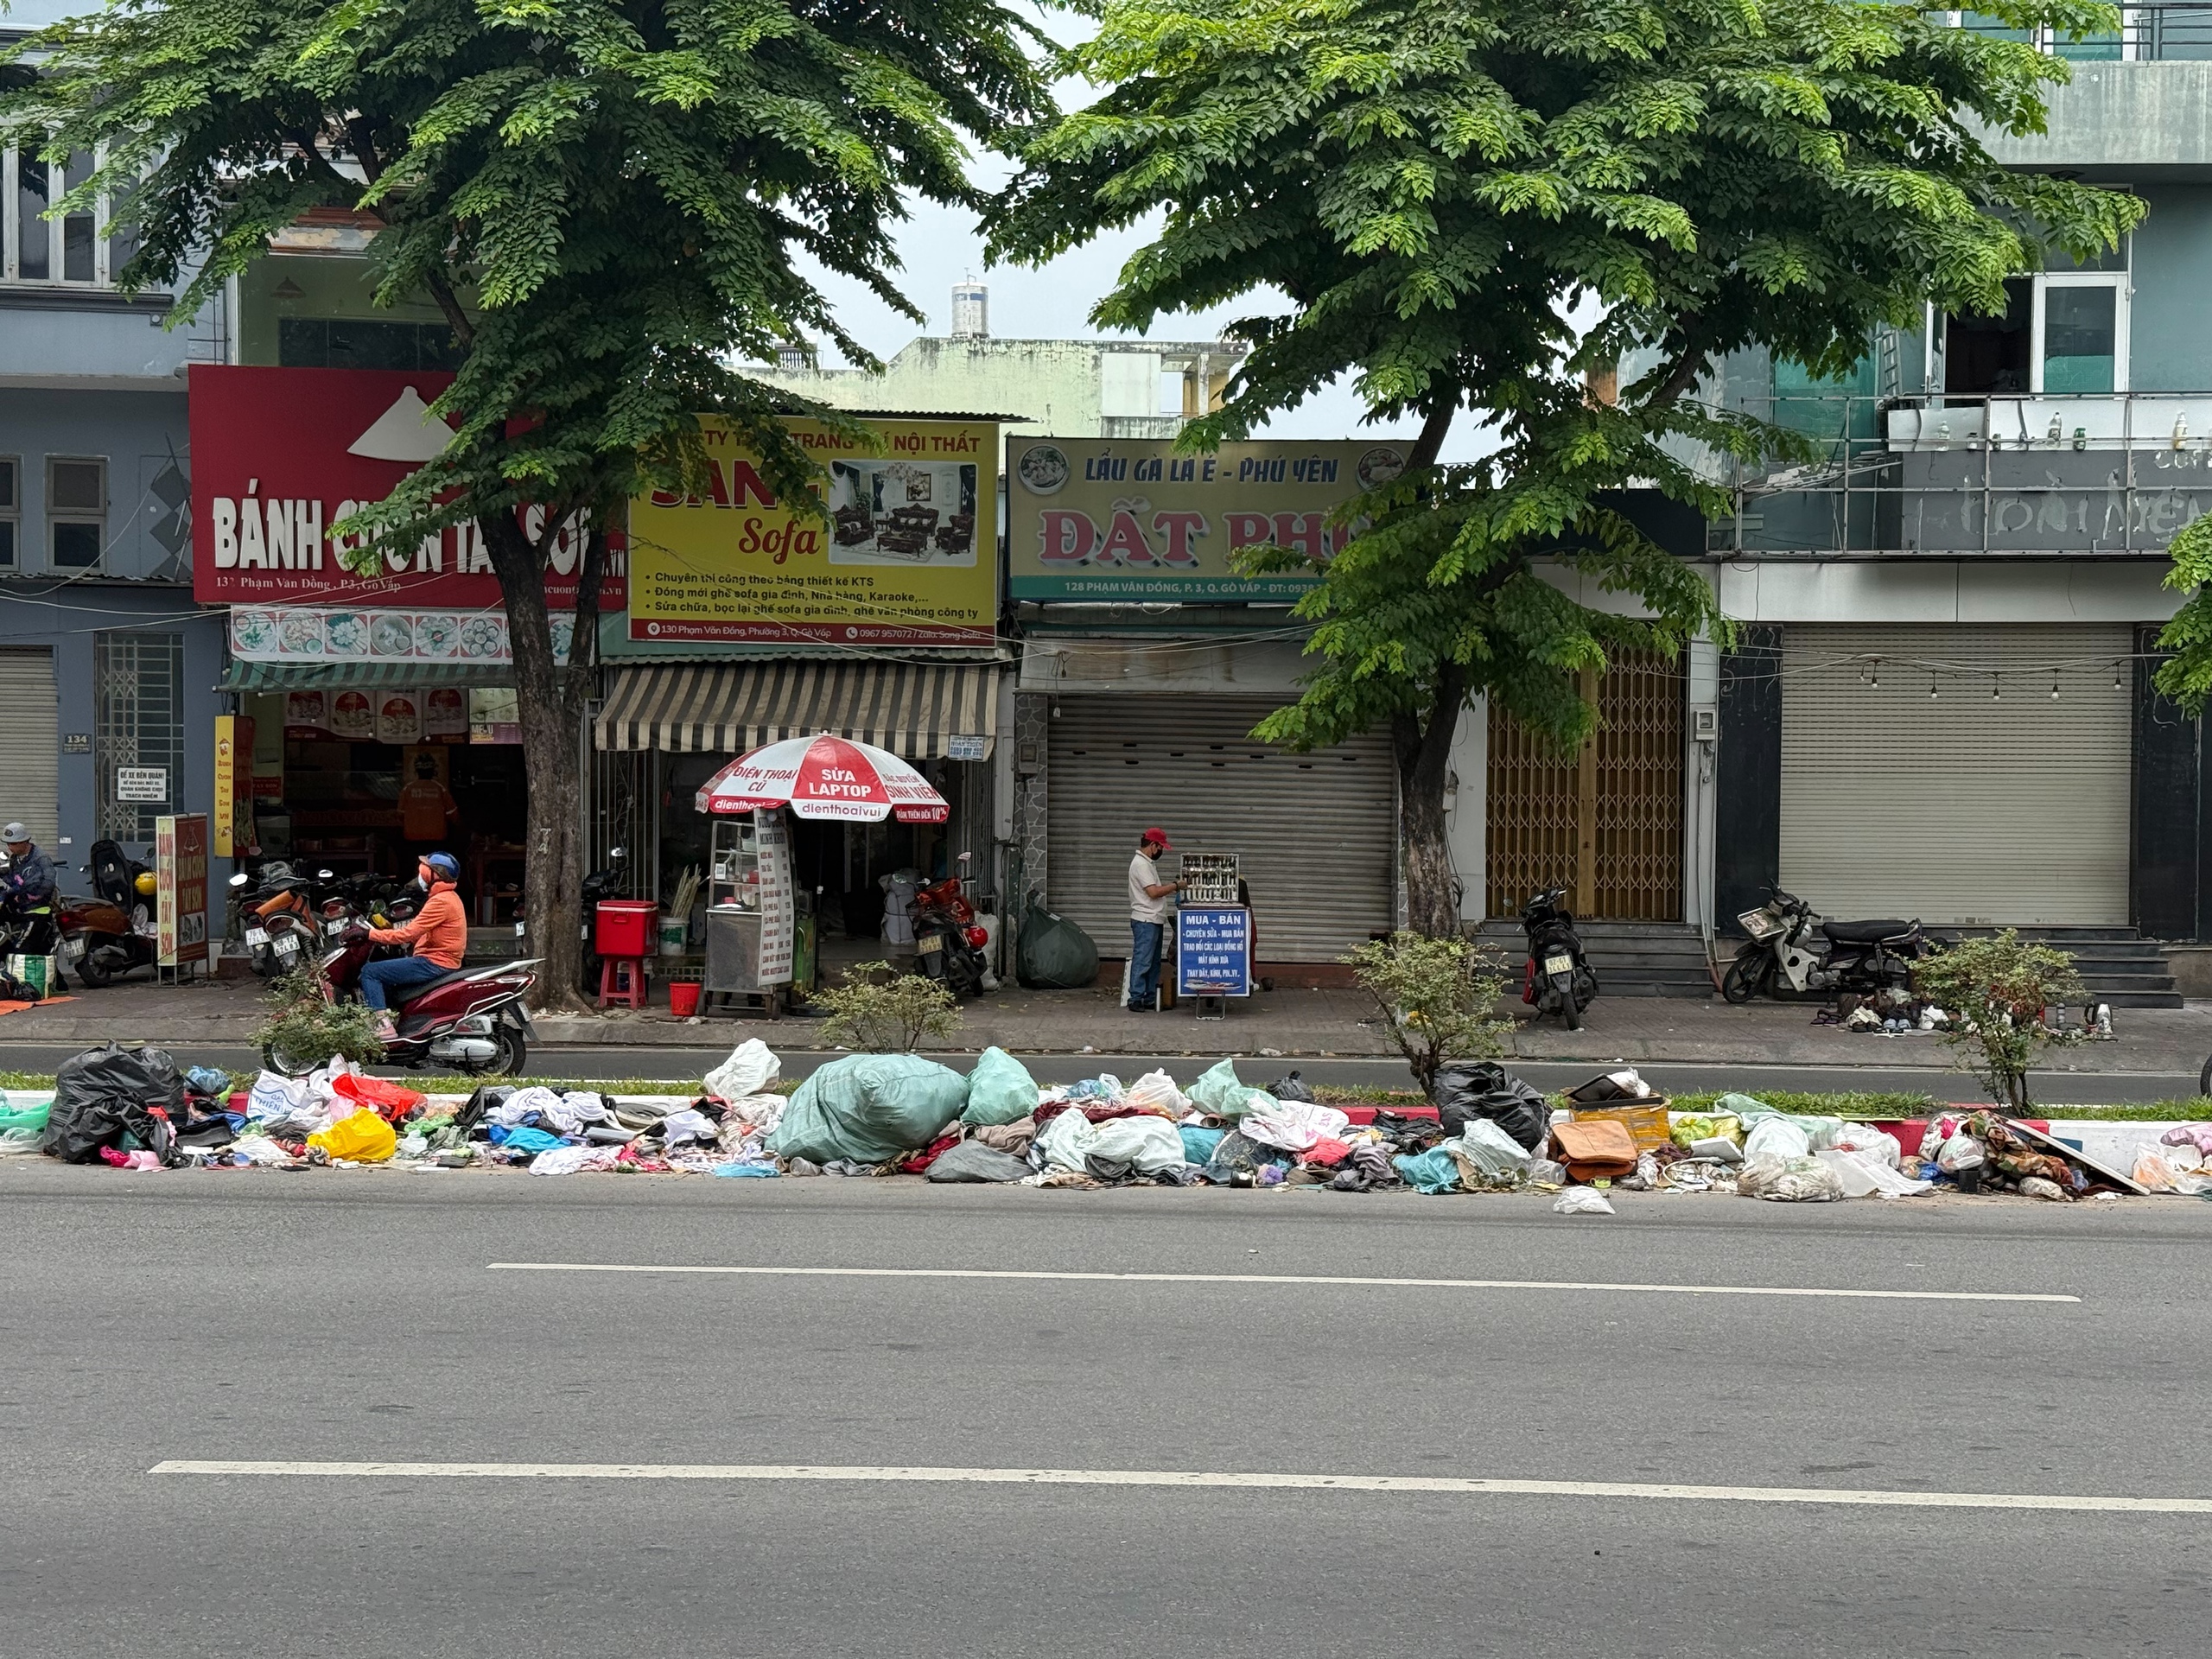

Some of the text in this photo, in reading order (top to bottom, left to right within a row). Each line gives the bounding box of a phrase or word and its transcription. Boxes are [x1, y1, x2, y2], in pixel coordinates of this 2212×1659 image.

[894, 432, 925, 455] NỘI
[931, 429, 981, 453] THẤT
[1085, 448, 1128, 481] LẨU
[1134, 454, 1163, 481] GÀ
[1170, 454, 1195, 482] LÁ
[1203, 454, 1217, 482] É
[1239, 454, 1287, 483] PHÚ
[1293, 454, 1338, 483] YÊN
[213, 479, 322, 570] BÁNH
[1039, 497, 1208, 567] ĐẤT
[739, 518, 821, 565] Sofa
[240, 577, 273, 592] Phạm
[655, 572, 698, 584] Chuyên
[748, 575, 774, 584] theo
[807, 576, 833, 586] thiết
[851, 577, 874, 587] KTS
[1065, 582, 1084, 591] 128
[1086, 582, 1122, 594] PHẠM
[1122, 582, 1145, 592] VĂN
[1185, 583, 1194, 592] P.
[1196, 584, 1205, 593] 3,
[1207, 583, 1219, 593] Q.
[1221, 582, 1237, 593] GÒ
[1239, 580, 1261, 593] VẤP
[1268, 583, 1287, 594] ĐT:
[655, 587, 684, 598] Đóng
[687, 588, 708, 597] mới
[734, 589, 759, 599] sofa
[761, 589, 778, 601] gia
[655, 601, 677, 612] Sửa
[715, 603, 734, 614] bọc
[738, 603, 751, 614] lại
[778, 605, 802, 614] sofa
[804, 606, 820, 616] gia
[938, 607, 964, 620] công
[967, 608, 978, 620] ty
[661, 625, 677, 633] 130
[678, 625, 702, 635] Phạm
[781, 628, 789, 638] 3,
[859, 629, 880, 638] 0967
[881, 630, 912, 639] 957072
[472, 724, 494, 734] MEU
[67, 735, 87, 744] 134
[733, 766, 799, 782] ĐIỆN THOẠI
[821, 766, 856, 783] SỬA
[747, 779, 767, 792] CŨ
[808, 782, 872, 798] LAPTOP
[884, 783, 941, 800] SINH VIÊN
[802, 804, 881, 817] dienthoaivui
[1186, 915, 1209, 925] MUA
[1219, 912, 1241, 925] BÁN
